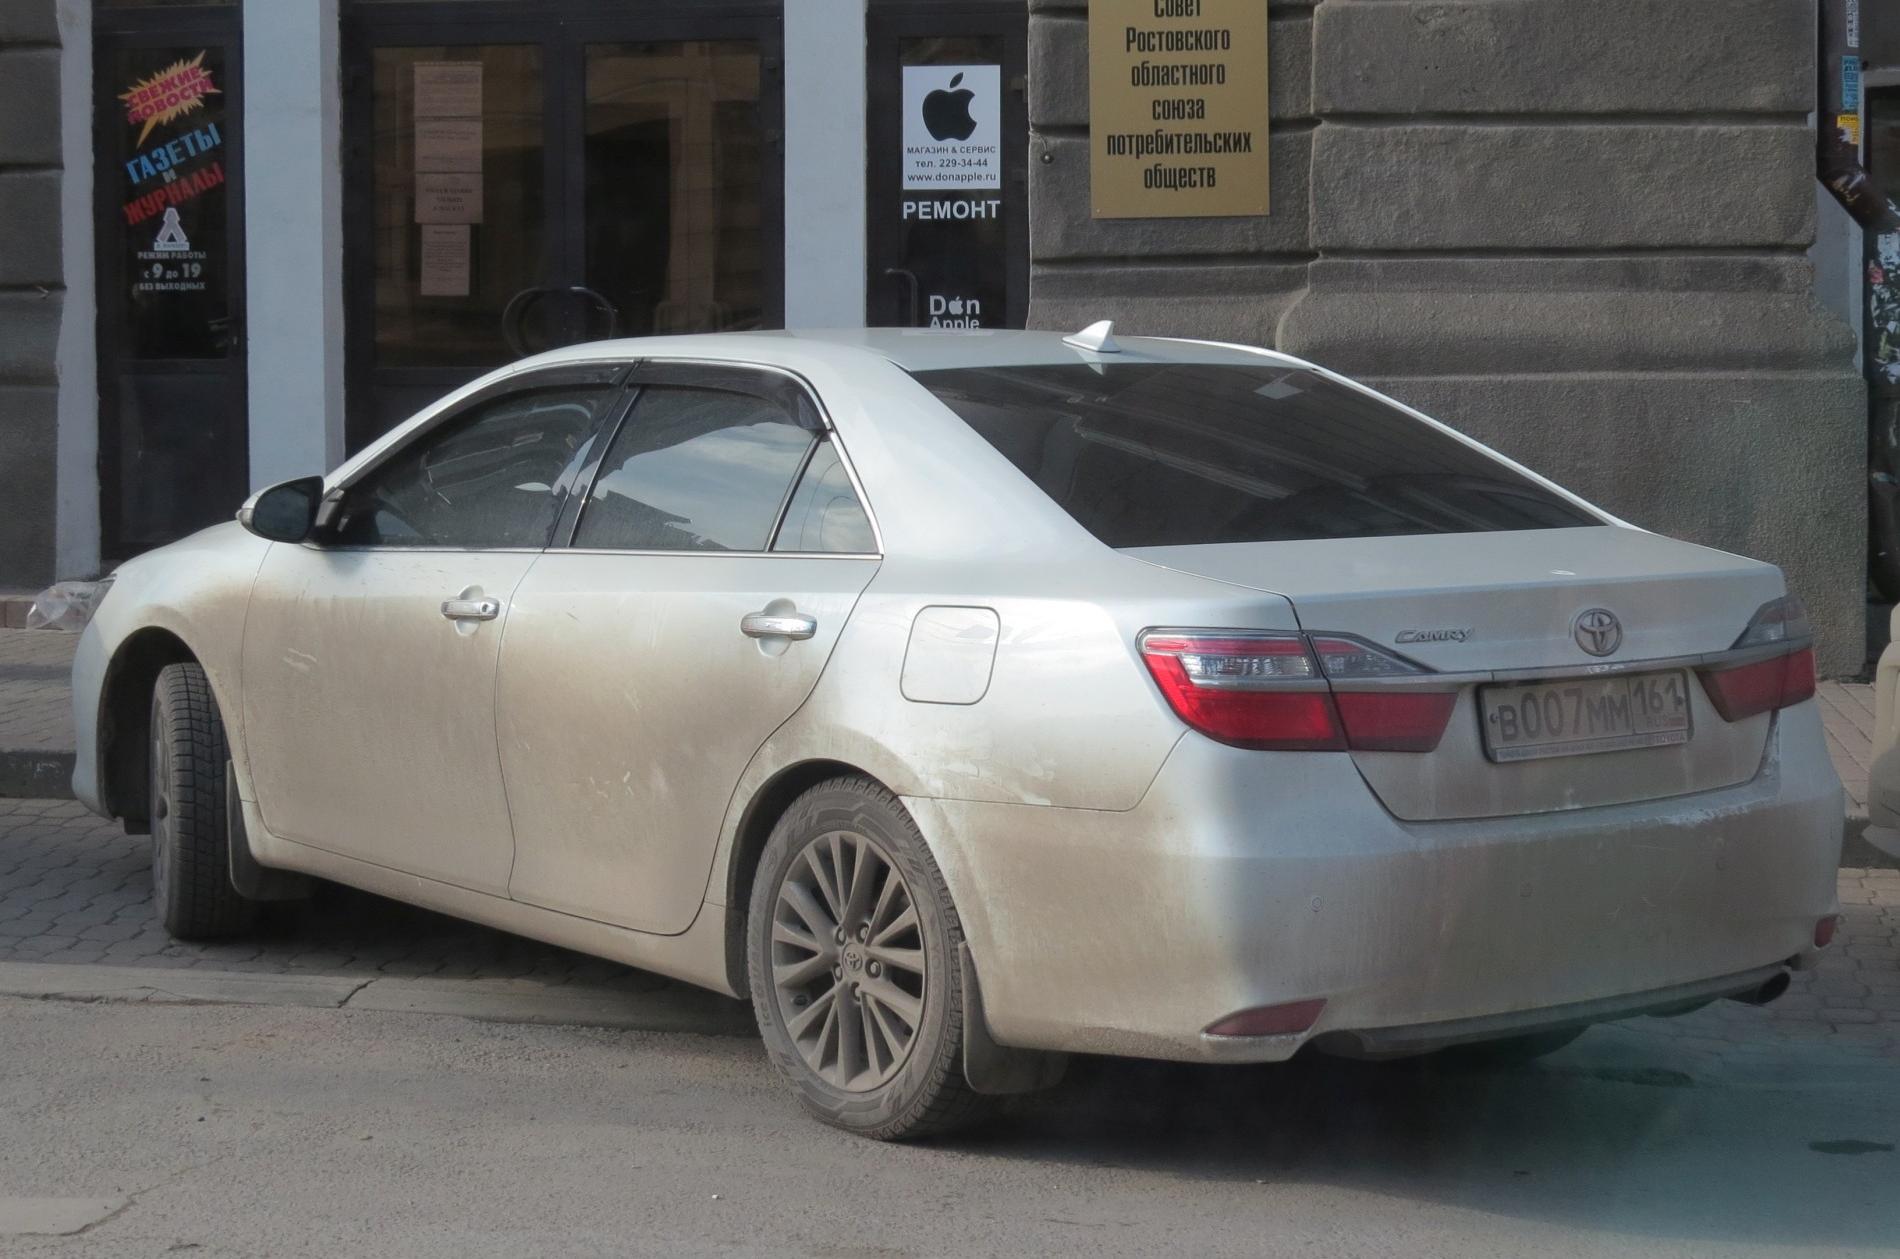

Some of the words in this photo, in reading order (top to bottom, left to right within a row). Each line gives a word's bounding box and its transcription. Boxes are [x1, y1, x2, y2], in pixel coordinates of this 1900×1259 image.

[1154, 0, 1201, 18] Совет
[1126, 26, 1231, 53] Ростовского
[1131, 61, 1226, 87] областного
[126, 65, 202, 108] СВЕЖИЕ
[127, 79, 216, 124] НОВОСТИ
[1152, 98, 1205, 121] союза
[125, 122, 222, 185] ГАЗЕТЫ
[907, 146, 949, 155] МАГАЗИН
[951, 146, 958, 154] &
[960, 146, 996, 154] СЕРВИС
[1107, 129, 1252, 160] потребительских
[915, 159, 937, 169] тел.
[939, 158, 988, 169] 229-34-44
[907, 172, 997, 183] www.donapple.ru
[1144, 163, 1216, 191] обществ
[122, 161, 224, 225] ЖУРНАЛЫ
[903, 200, 1001, 220] РЕМОНТ
[137, 251, 169, 260] РЕЖИМ
[171, 251, 207, 260] РАБОТЫ
[152, 262, 163, 279] 9
[165, 269, 179, 279] до
[182, 262, 202, 278] 19
[155, 282, 206, 291] ВЫХОДНЫХ
